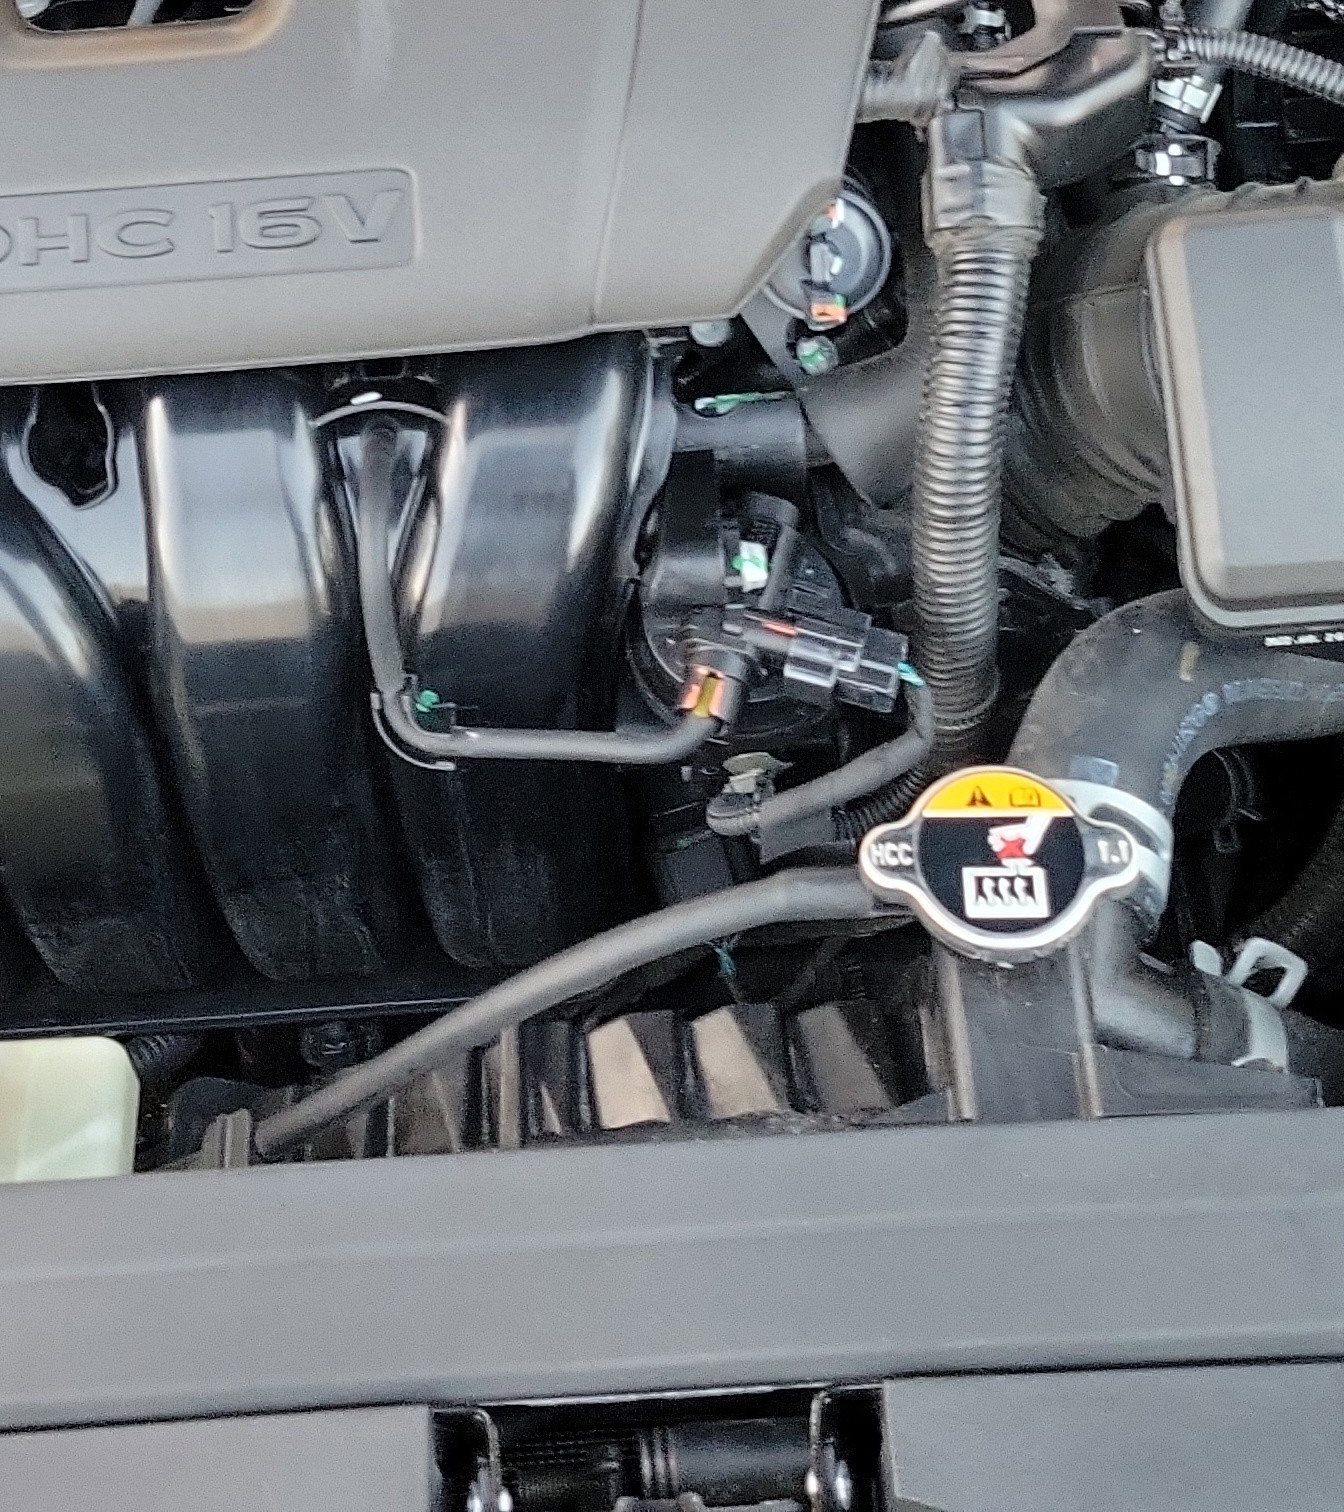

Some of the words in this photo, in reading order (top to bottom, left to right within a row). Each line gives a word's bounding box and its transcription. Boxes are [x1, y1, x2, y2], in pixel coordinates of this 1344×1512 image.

[208, 189, 404, 254] 16V
[869, 841, 915, 866] HCC
[1096, 840, 1131, 865] 1.1
